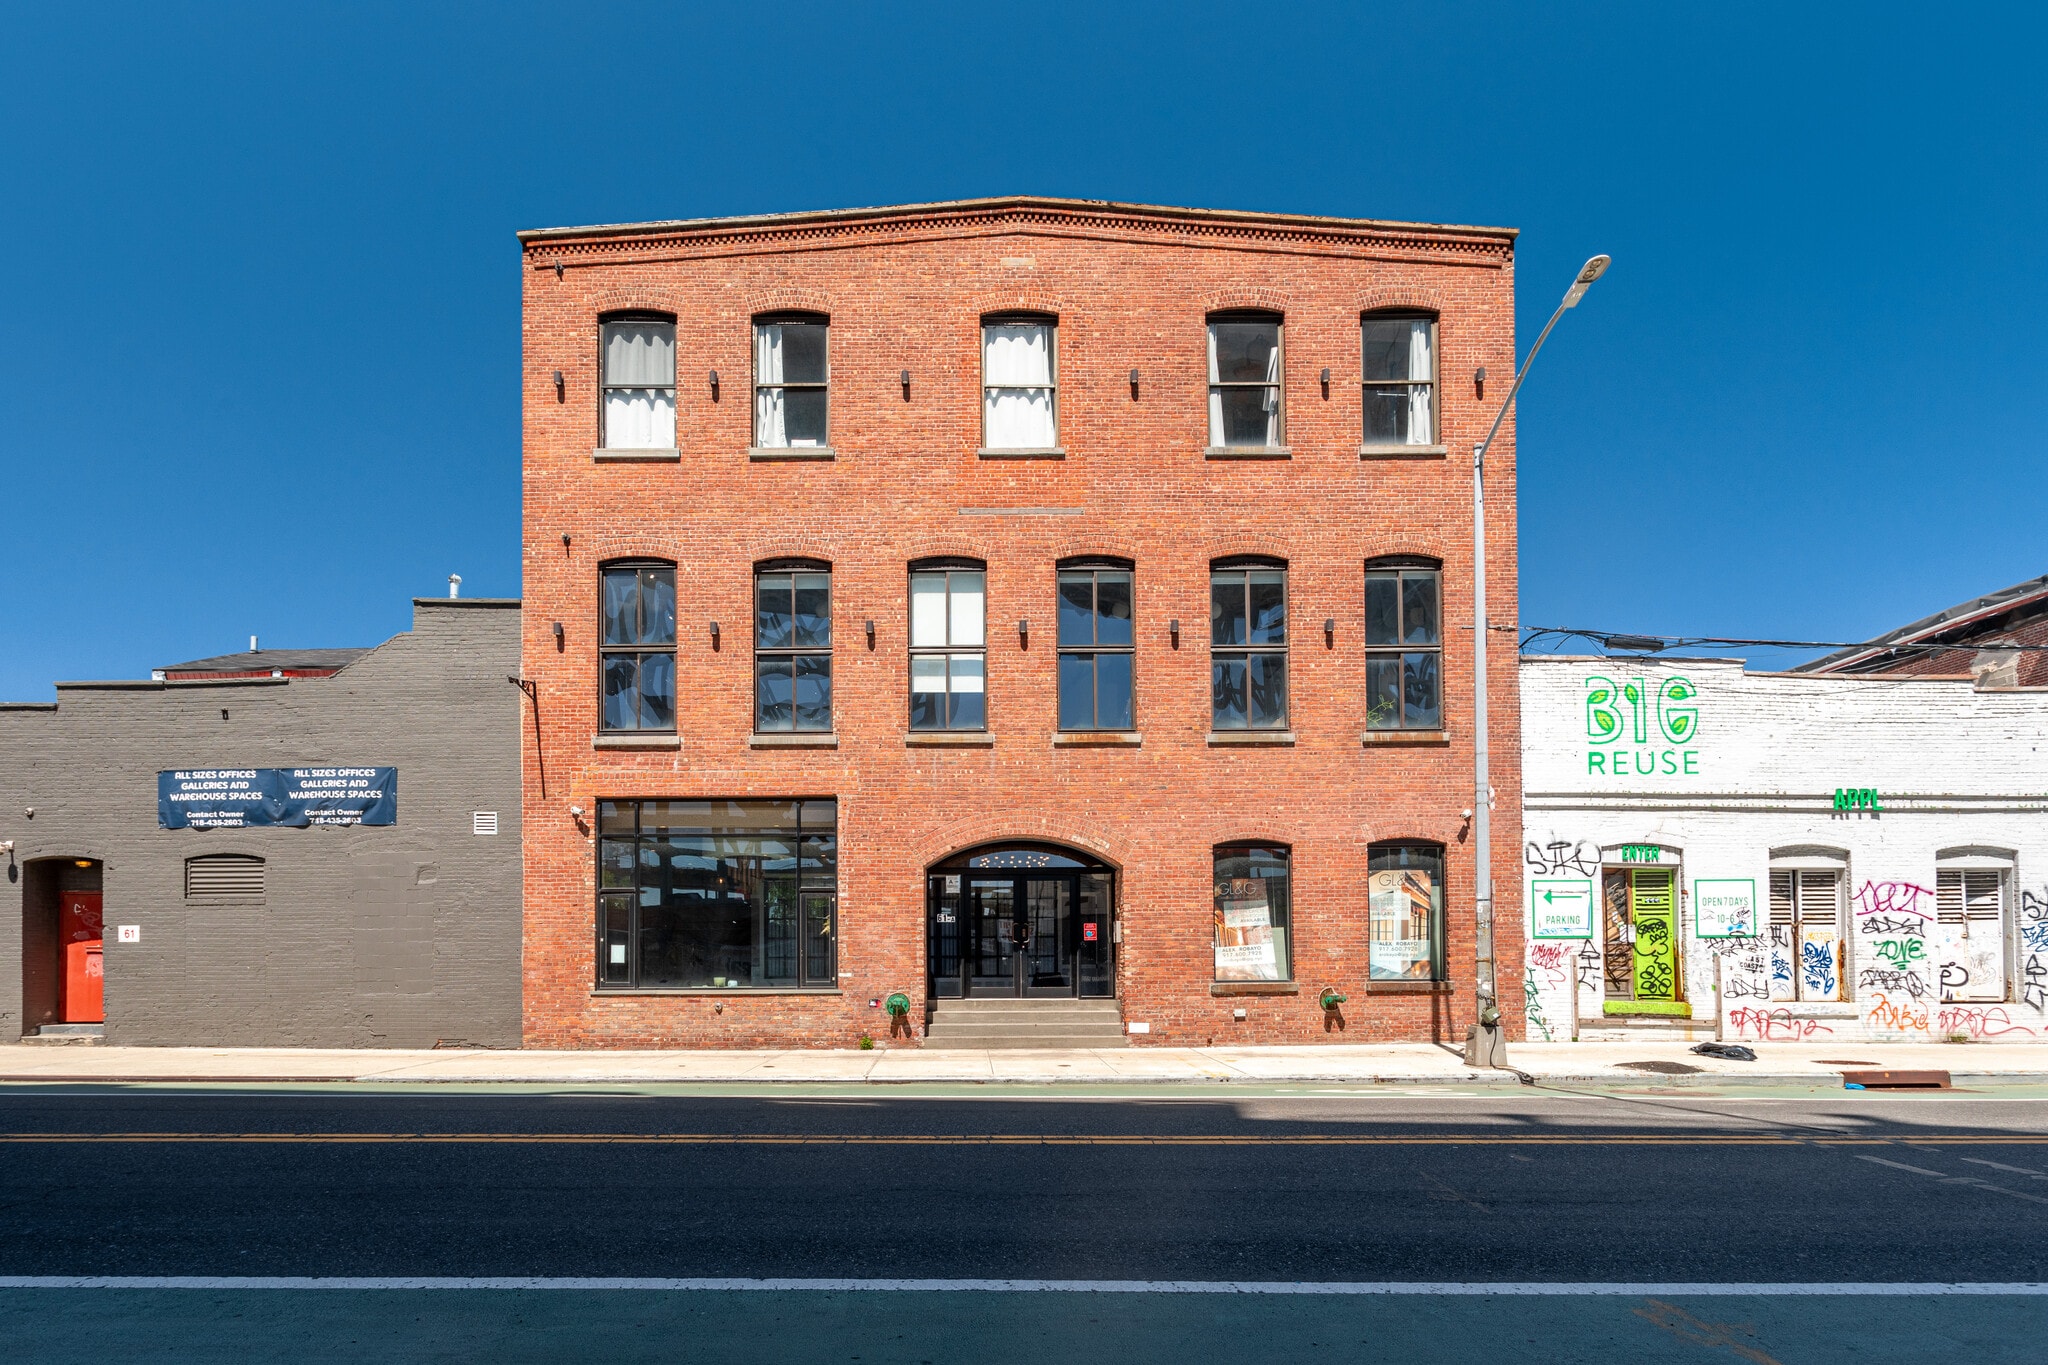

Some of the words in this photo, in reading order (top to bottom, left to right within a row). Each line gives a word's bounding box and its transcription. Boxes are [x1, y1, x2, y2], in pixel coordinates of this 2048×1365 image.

[1585, 676, 1698, 744] BIG
[1588, 751, 1699, 775] REUSE
[175, 772, 192, 780] ALL
[192, 770, 217, 779] SIZES
[218, 770, 256, 779] OFFICES
[294, 770, 310, 778] ALL
[312, 769, 336, 777] SIZES
[338, 769, 376, 777] OFFICES
[181, 782, 228, 790] GALLERIES
[300, 780, 347, 788] GALLERIES
[349, 780, 368, 788] AND
[170, 793, 227, 801] WAREHOUSE
[228, 792, 262, 800] SPACES
[289, 791, 346, 799] WAREHOUSE
[347, 790, 382, 798] SPACES
[1833, 788, 1884, 811] APPL
[1622, 845, 1660, 862] ENTER
[1218, 882, 1256, 895] GL&G
[1702, 897, 1722, 906] OPEN
[1729, 897, 1749, 906] DAYS
[1546, 916, 1581, 924] PARKING
[1718, 914, 1735, 924] 10-6
[125, 929, 134, 938] 61
